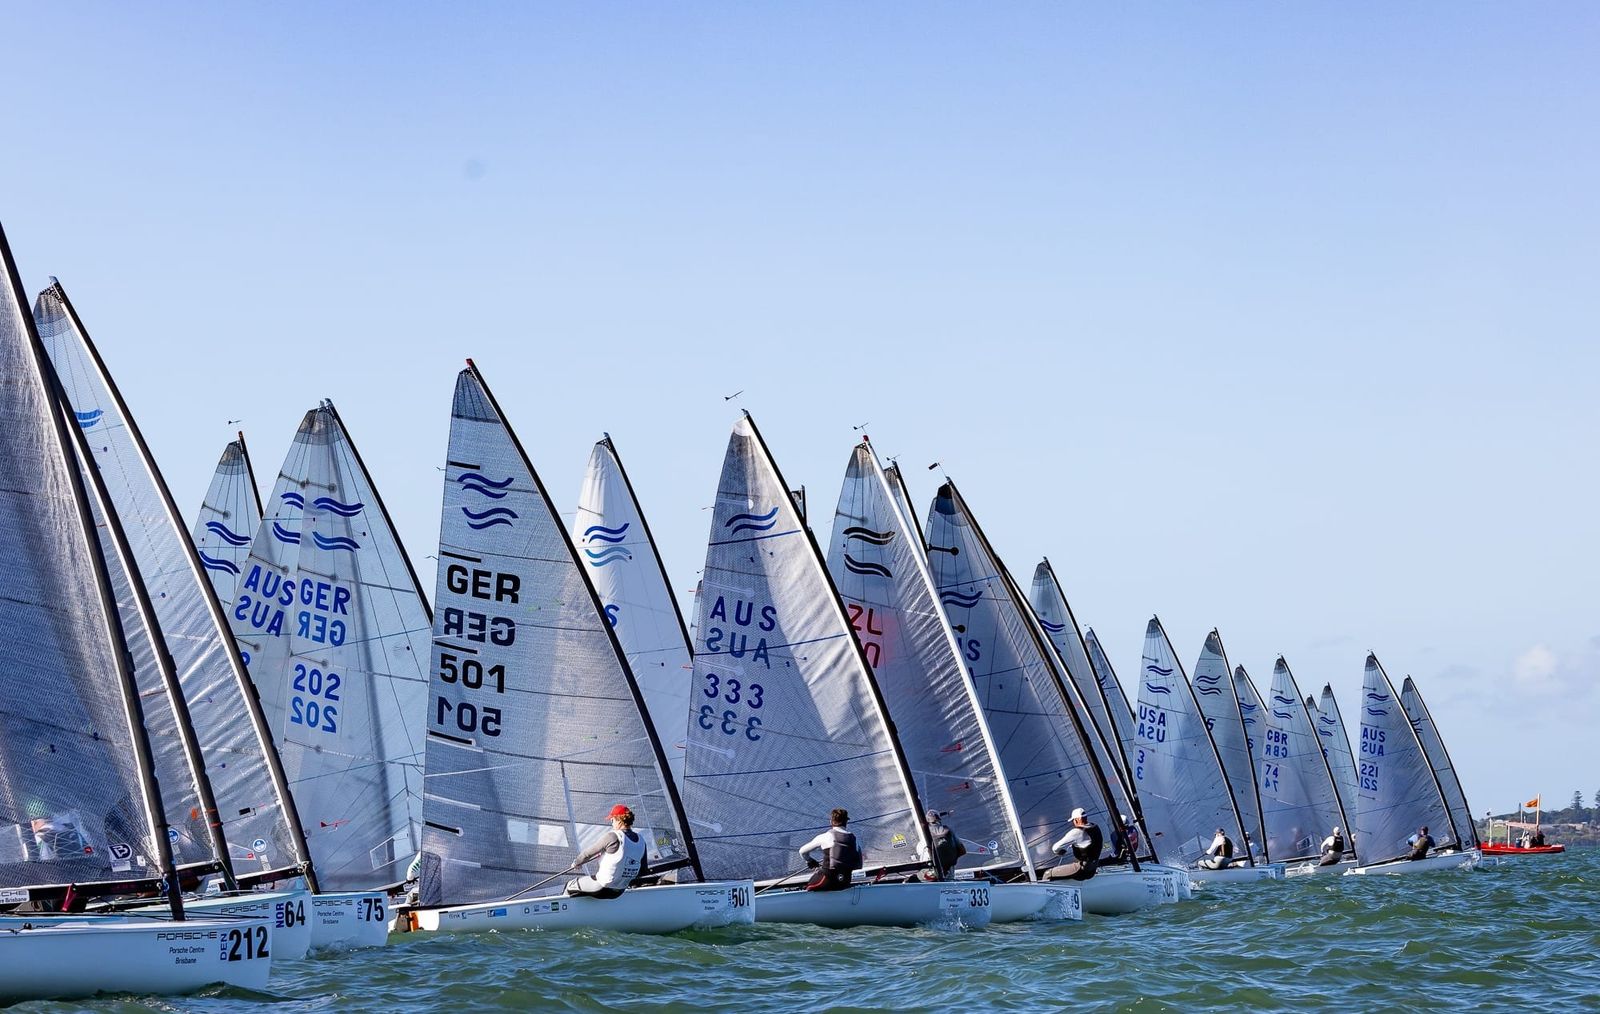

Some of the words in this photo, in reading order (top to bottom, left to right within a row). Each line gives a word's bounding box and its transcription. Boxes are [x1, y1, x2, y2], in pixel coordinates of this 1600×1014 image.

[244, 565, 296, 606] AUS
[447, 564, 521, 604] GER
[301, 578, 350, 615] GER
[710, 596, 776, 632] AUS
[293, 664, 341, 701] 202
[440, 653, 505, 693] 501
[704, 674, 764, 709] 333
[1140, 706, 1166, 727] USA
[1362, 728, 1386, 743] AUS
[1137, 750, 1145, 764] 3
[1265, 764, 1278, 778] 74
[1361, 763, 1378, 778] 221
[221, 903, 269, 914] PORSCHE
[732, 886, 750, 908] 501
[970, 889, 989, 907] 333
[276, 903, 284, 928] NOR
[285, 900, 305, 928] 64
[363, 898, 384, 922] 75
[157, 931, 217, 941] PORSCHE
[228, 926, 269, 961] 212
